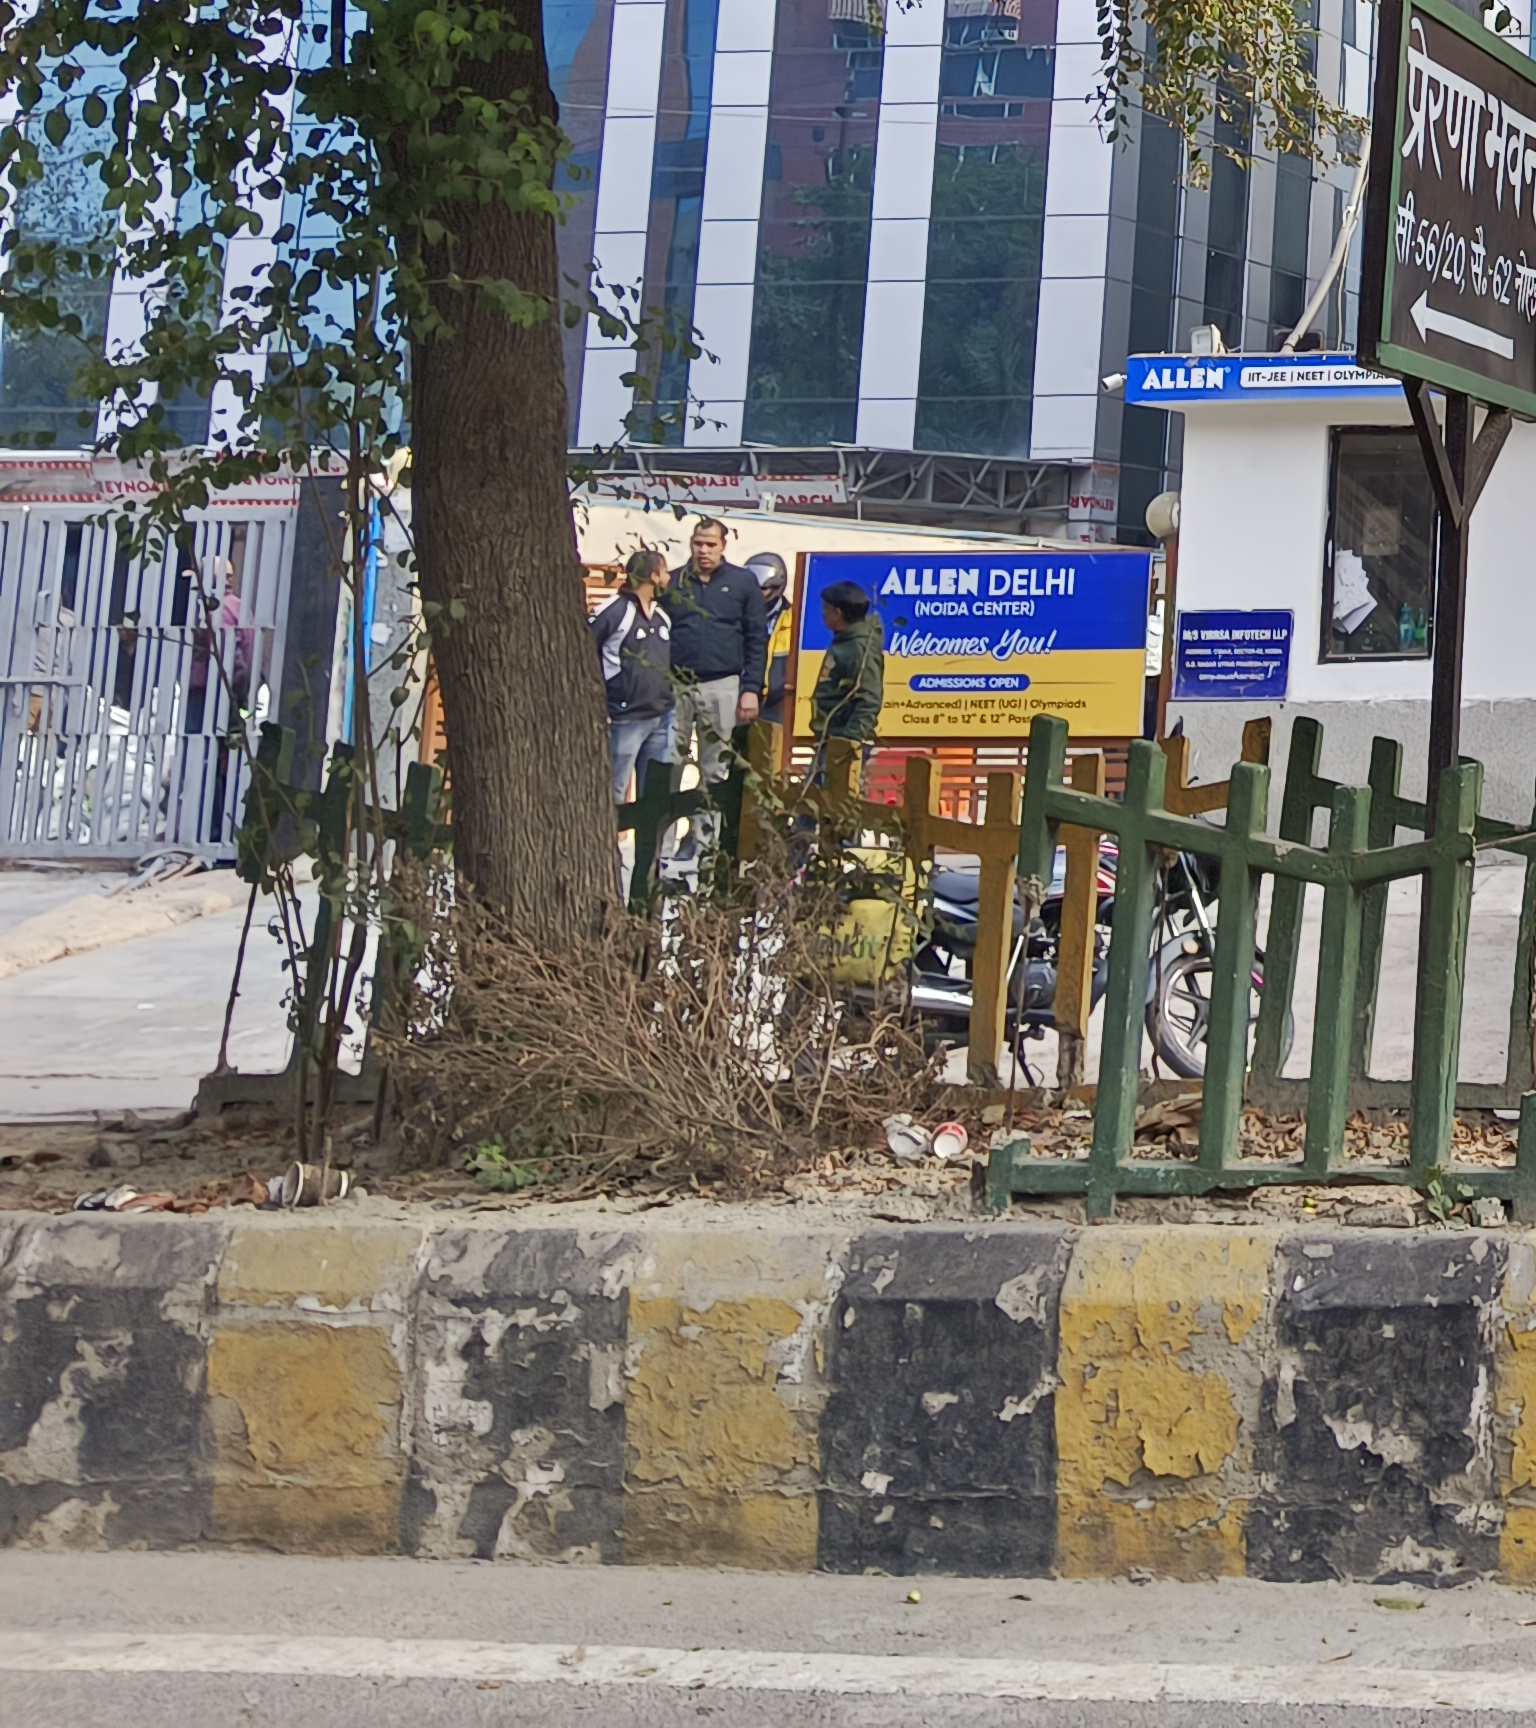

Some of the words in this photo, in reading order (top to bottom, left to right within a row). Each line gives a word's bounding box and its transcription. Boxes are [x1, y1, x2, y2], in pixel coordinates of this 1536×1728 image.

[1401, 16, 1485, 195] प्रेरणा
[1142, 367, 1224, 390] ALLEN
[1248, 371, 1286, 382] IIT-JEE
[1297, 371, 1323, 381] NEET
[880, 567, 979, 596] ALLEN
[989, 567, 1075, 596] DELHI
[915, 599, 969, 617] (NOIDA
[972, 599, 1035, 617] CENTER)
[889, 629, 989, 657] Welcomes
[991, 628, 1057, 661] You!
[918, 677, 985, 688] ADMISSIONS
[989, 677, 1019, 688] OPEN
